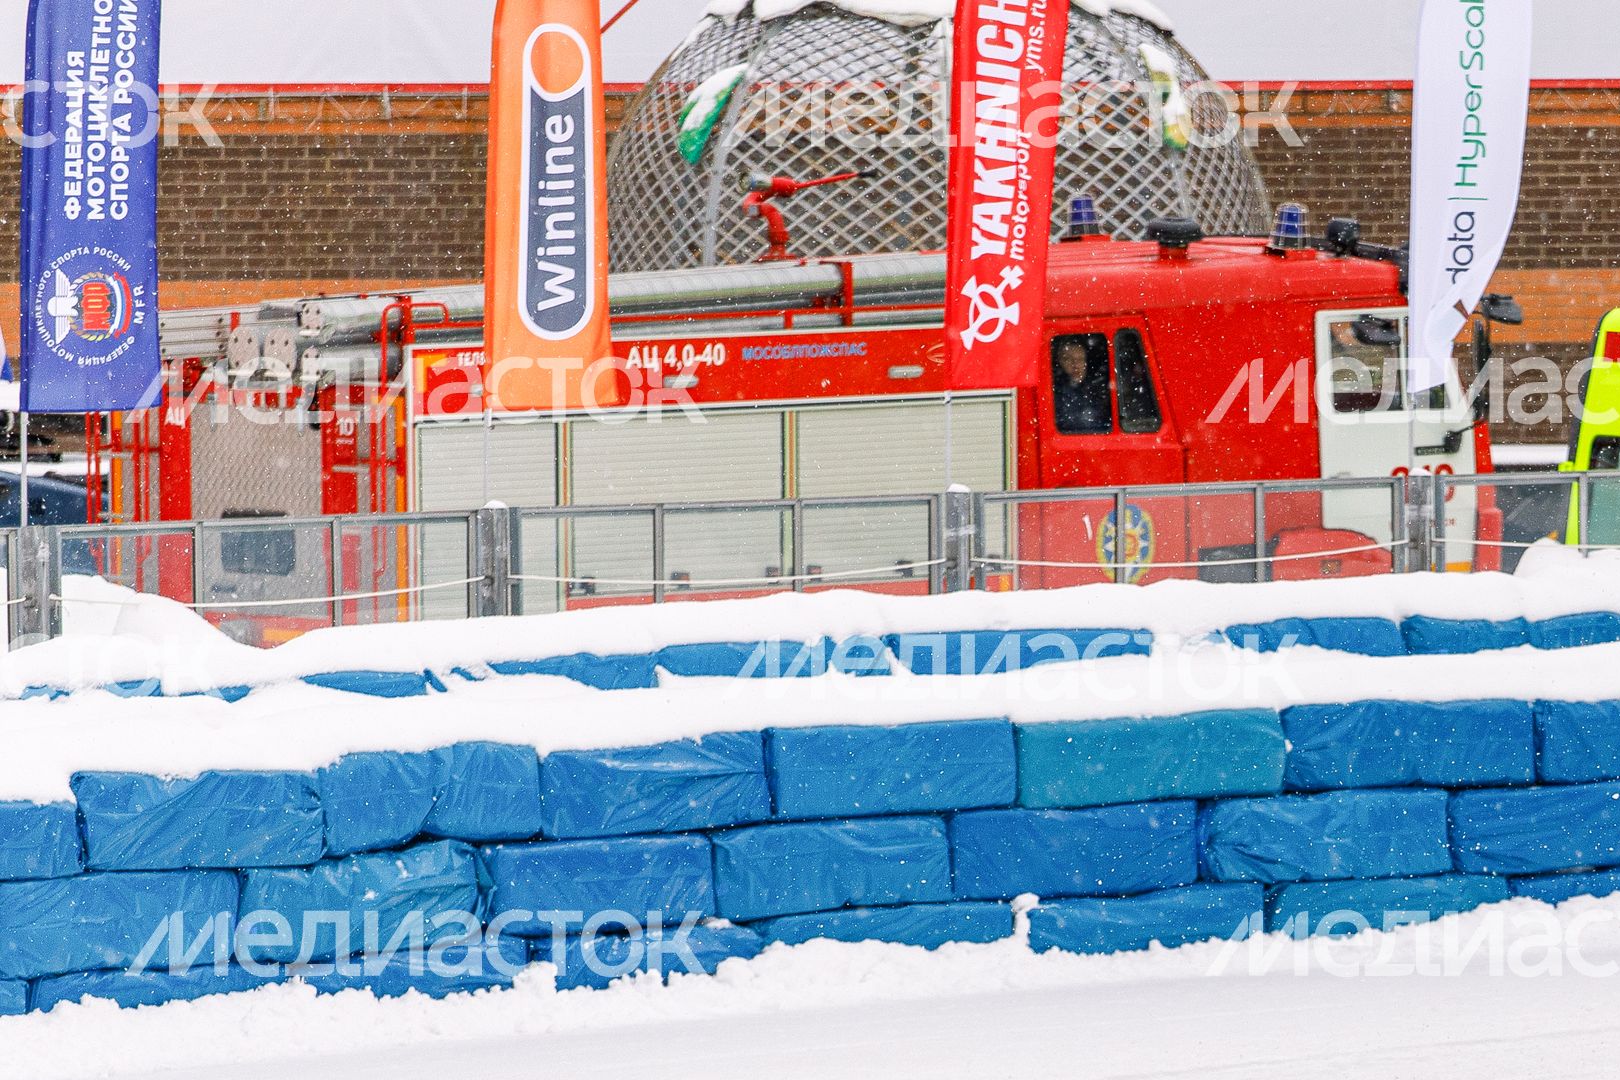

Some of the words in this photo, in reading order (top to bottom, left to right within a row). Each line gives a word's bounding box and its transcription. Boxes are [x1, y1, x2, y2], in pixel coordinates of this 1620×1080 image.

[1024, 0, 1048, 75] yms.ru
[64, 51, 85, 220] ФЕДЕРАЦИЯ
[87, 0, 114, 220] МОТОЦИКЛЕТНО
[970, 0, 1028, 260] YAKHNICH
[110, 112, 132, 221] СПОРТА
[1009, 131, 1033, 260] motorsport
[51, 246, 90, 270] СПОРТА
[93, 246, 132, 271] РОССИИ
[133, 284, 146, 325] MFR
[625, 346, 659, 372] АЦ
